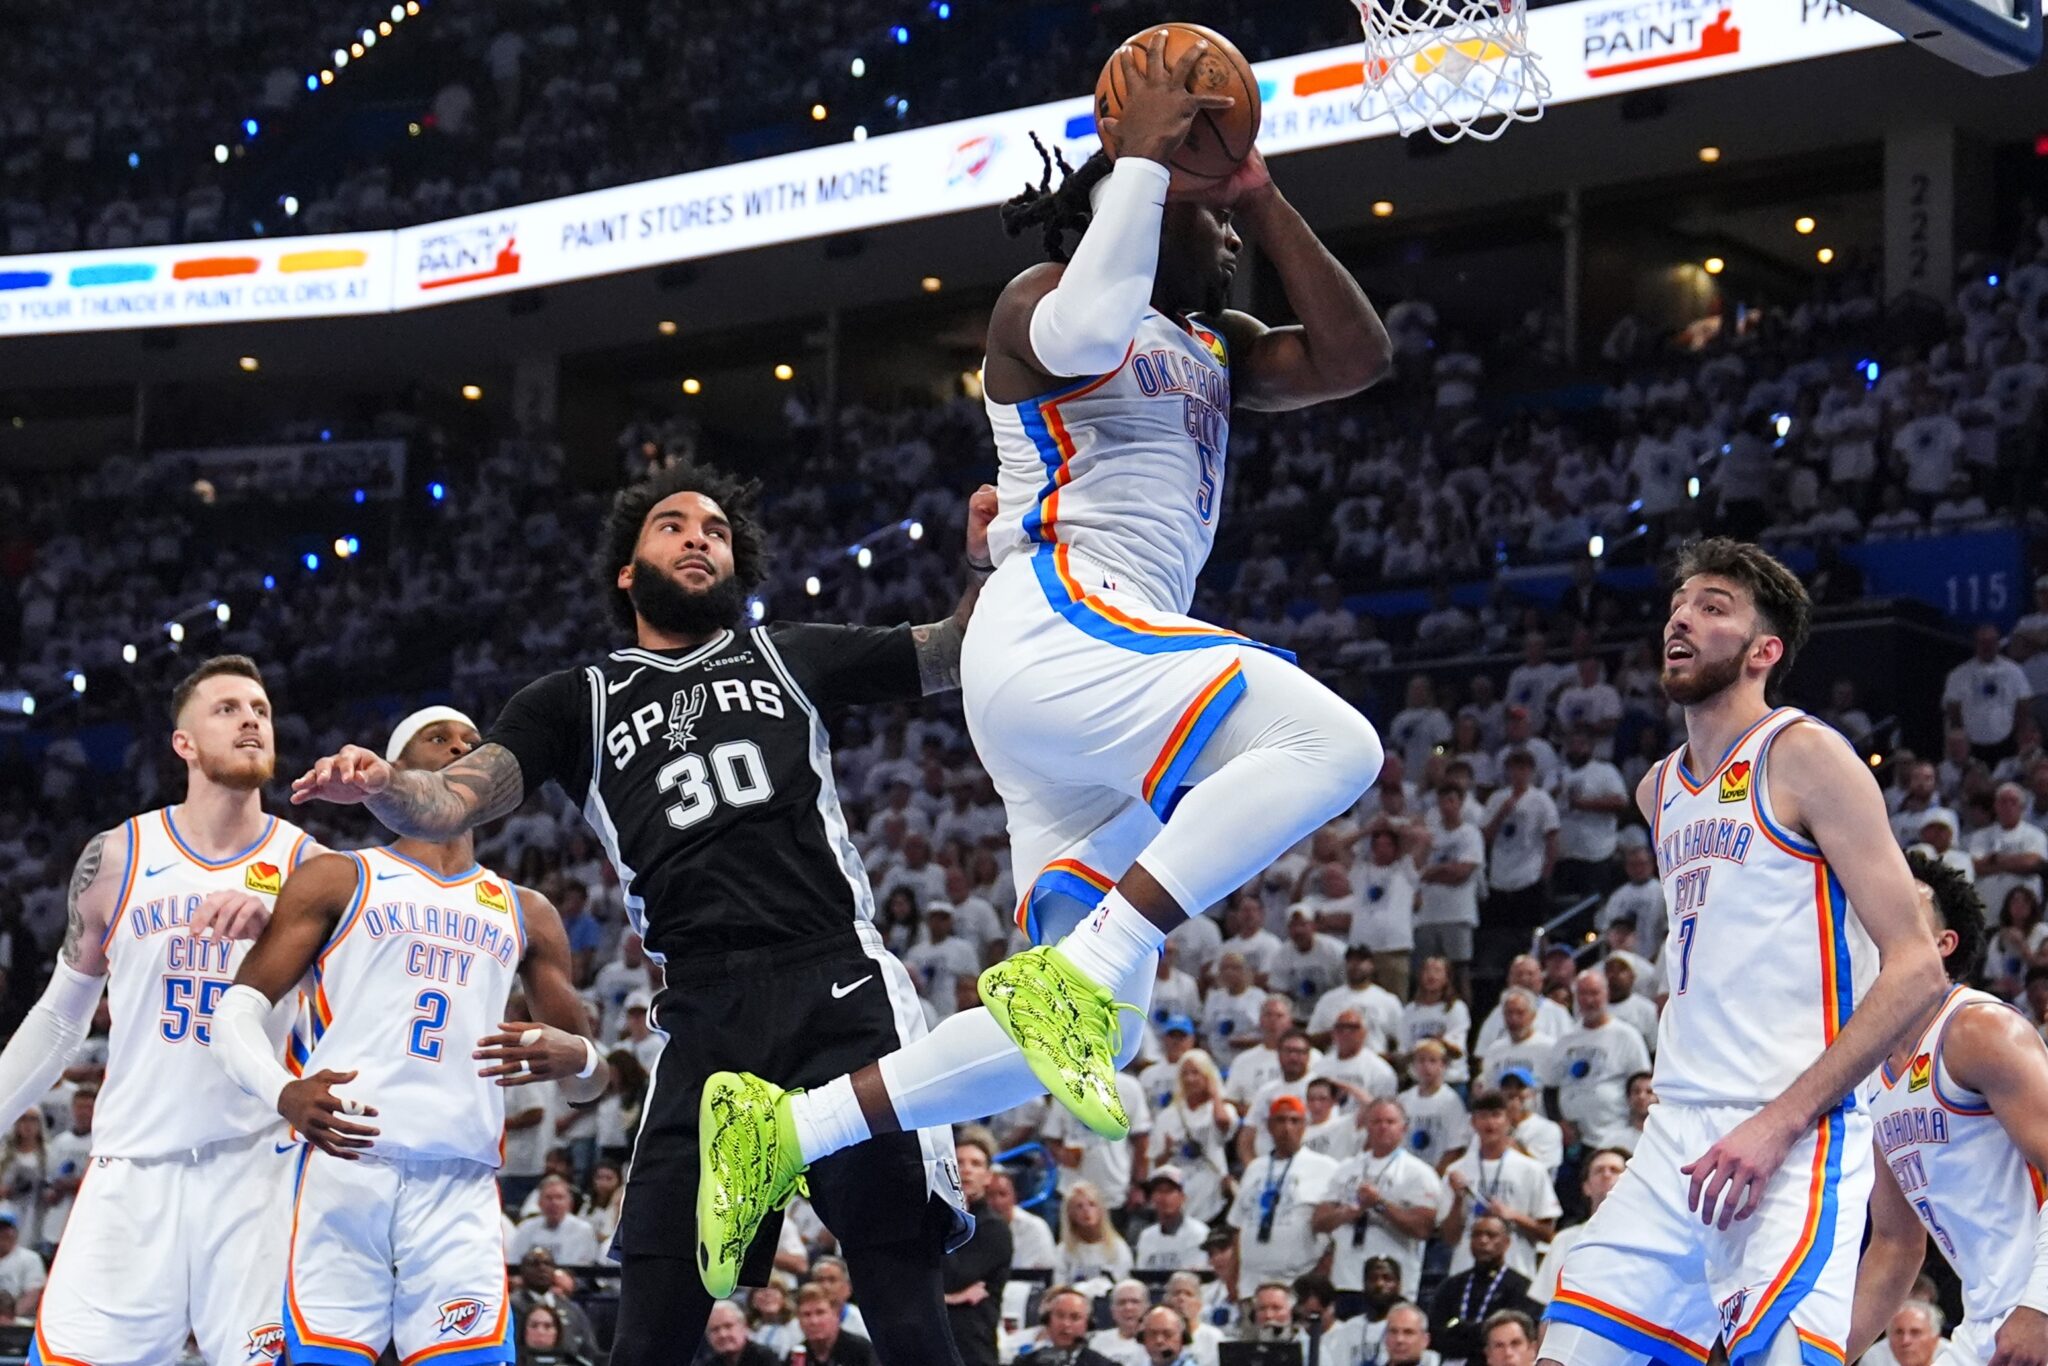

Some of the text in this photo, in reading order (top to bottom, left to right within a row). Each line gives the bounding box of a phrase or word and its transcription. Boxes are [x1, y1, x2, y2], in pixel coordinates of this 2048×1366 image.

[1585, 19, 1701, 59] PAINT
[562, 163, 890, 249] PAINT STORES WITH MORE
[419, 241, 495, 272] PAINT
[20, 298, 71, 318] YOUR
[81, 291, 175, 314] THUNDER
[186, 286, 243, 309] PAINT
[254, 281, 336, 305] COLORS
[346, 279, 368, 298] AT
[1196, 441, 1217, 525] 5
[1946, 571, 2008, 615] 115
[709, 654, 747, 668] LEDGER
[655, 739, 775, 830] 30
[1675, 866, 1712, 915] CITY
[130, 893, 203, 940] OKLA
[363, 901, 516, 968] OKLAHOMA
[167, 934, 235, 973] CITY
[406, 940, 475, 987] CITY
[1678, 912, 1697, 995] 7
[159, 974, 234, 1047] 55
[407, 987, 452, 1062] 2
[440, 1303, 475, 1332] OKC
